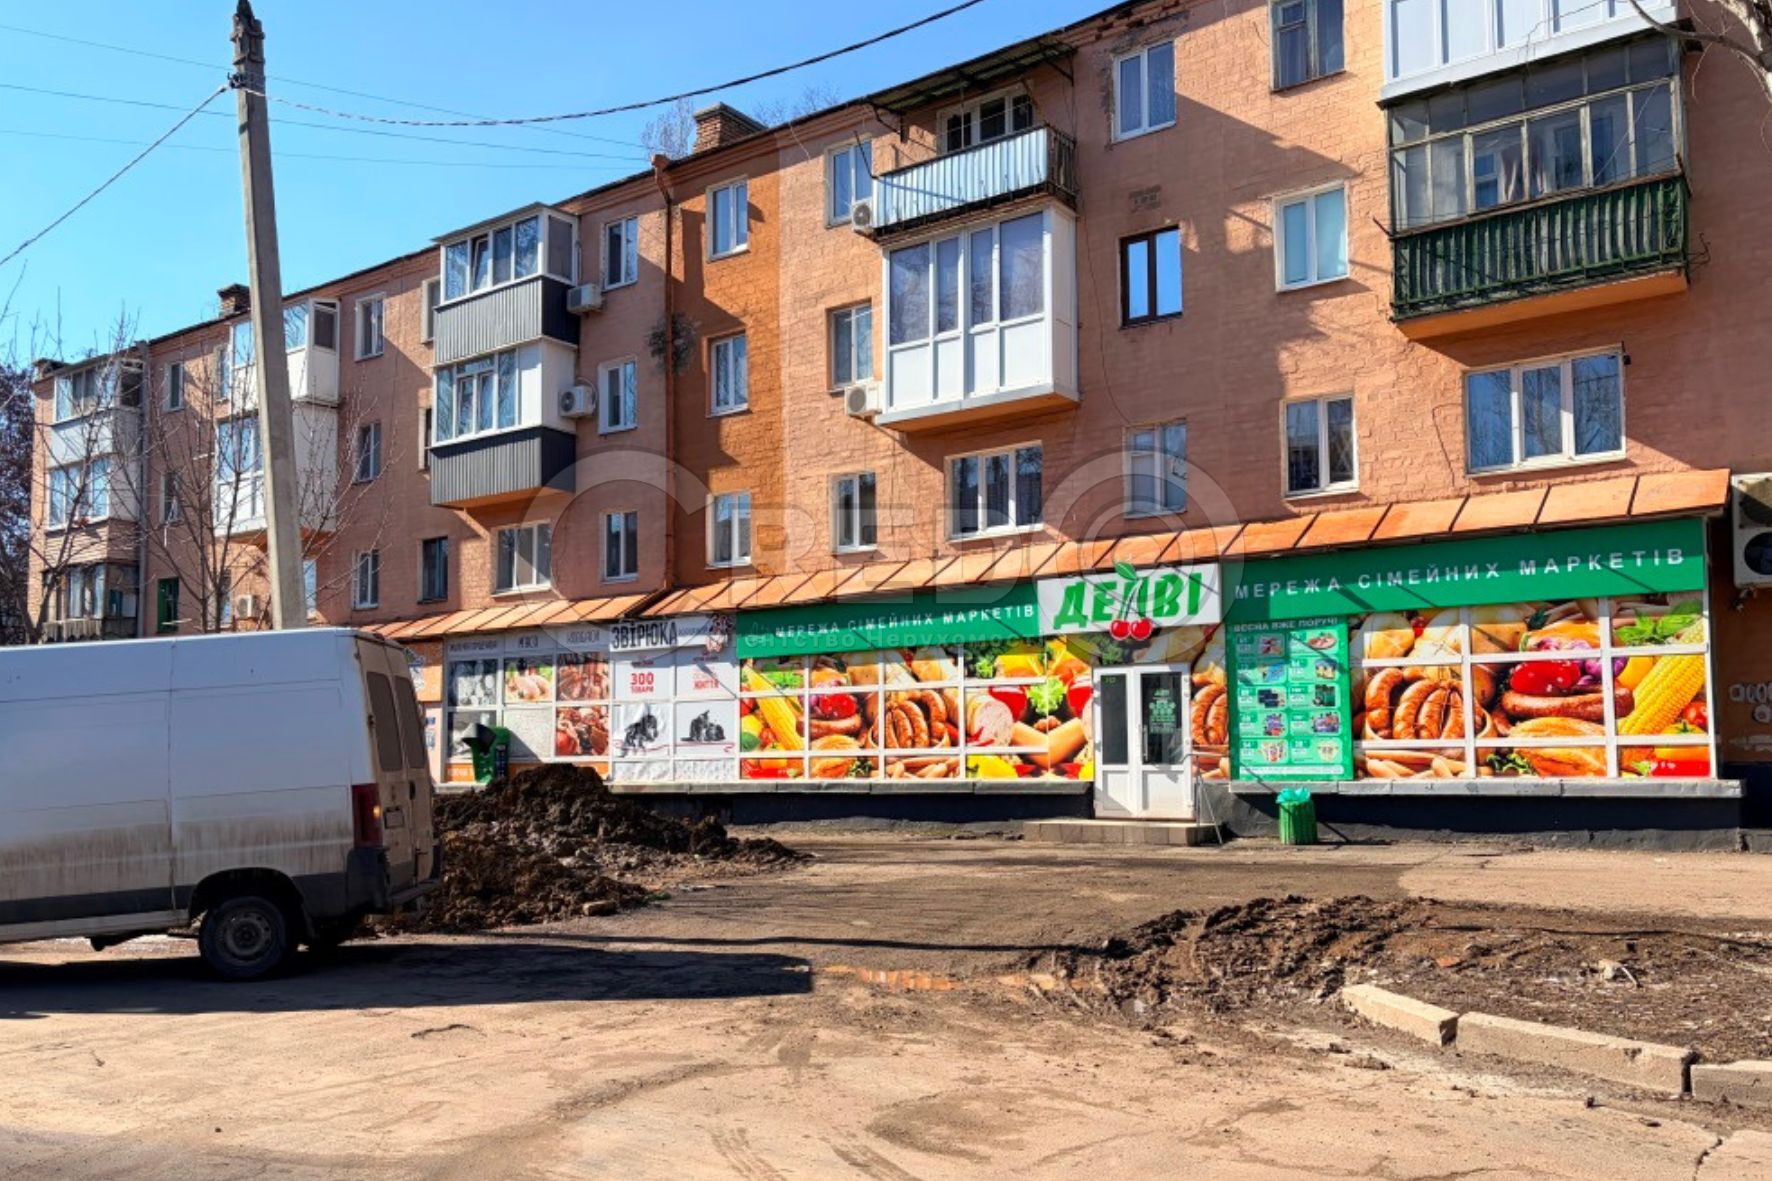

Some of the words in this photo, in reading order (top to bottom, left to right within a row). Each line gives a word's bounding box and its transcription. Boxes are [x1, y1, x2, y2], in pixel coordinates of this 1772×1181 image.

[1235, 576, 1341, 599] МЕРЕЖА
[1358, 563, 1500, 589] СІМЕЙНИХ
[1519, 548, 1684, 576] МАРКЕТІВ
[775, 622, 841, 638] МЕРЕЖА
[847, 612, 934, 632] СІМЕЙНИХ
[943, 604, 1034, 624] МАРКЕТІВ
[1053, 572, 1202, 630] ДЕЛВІ
[611, 621, 678, 649] ЗВІРЮКА
